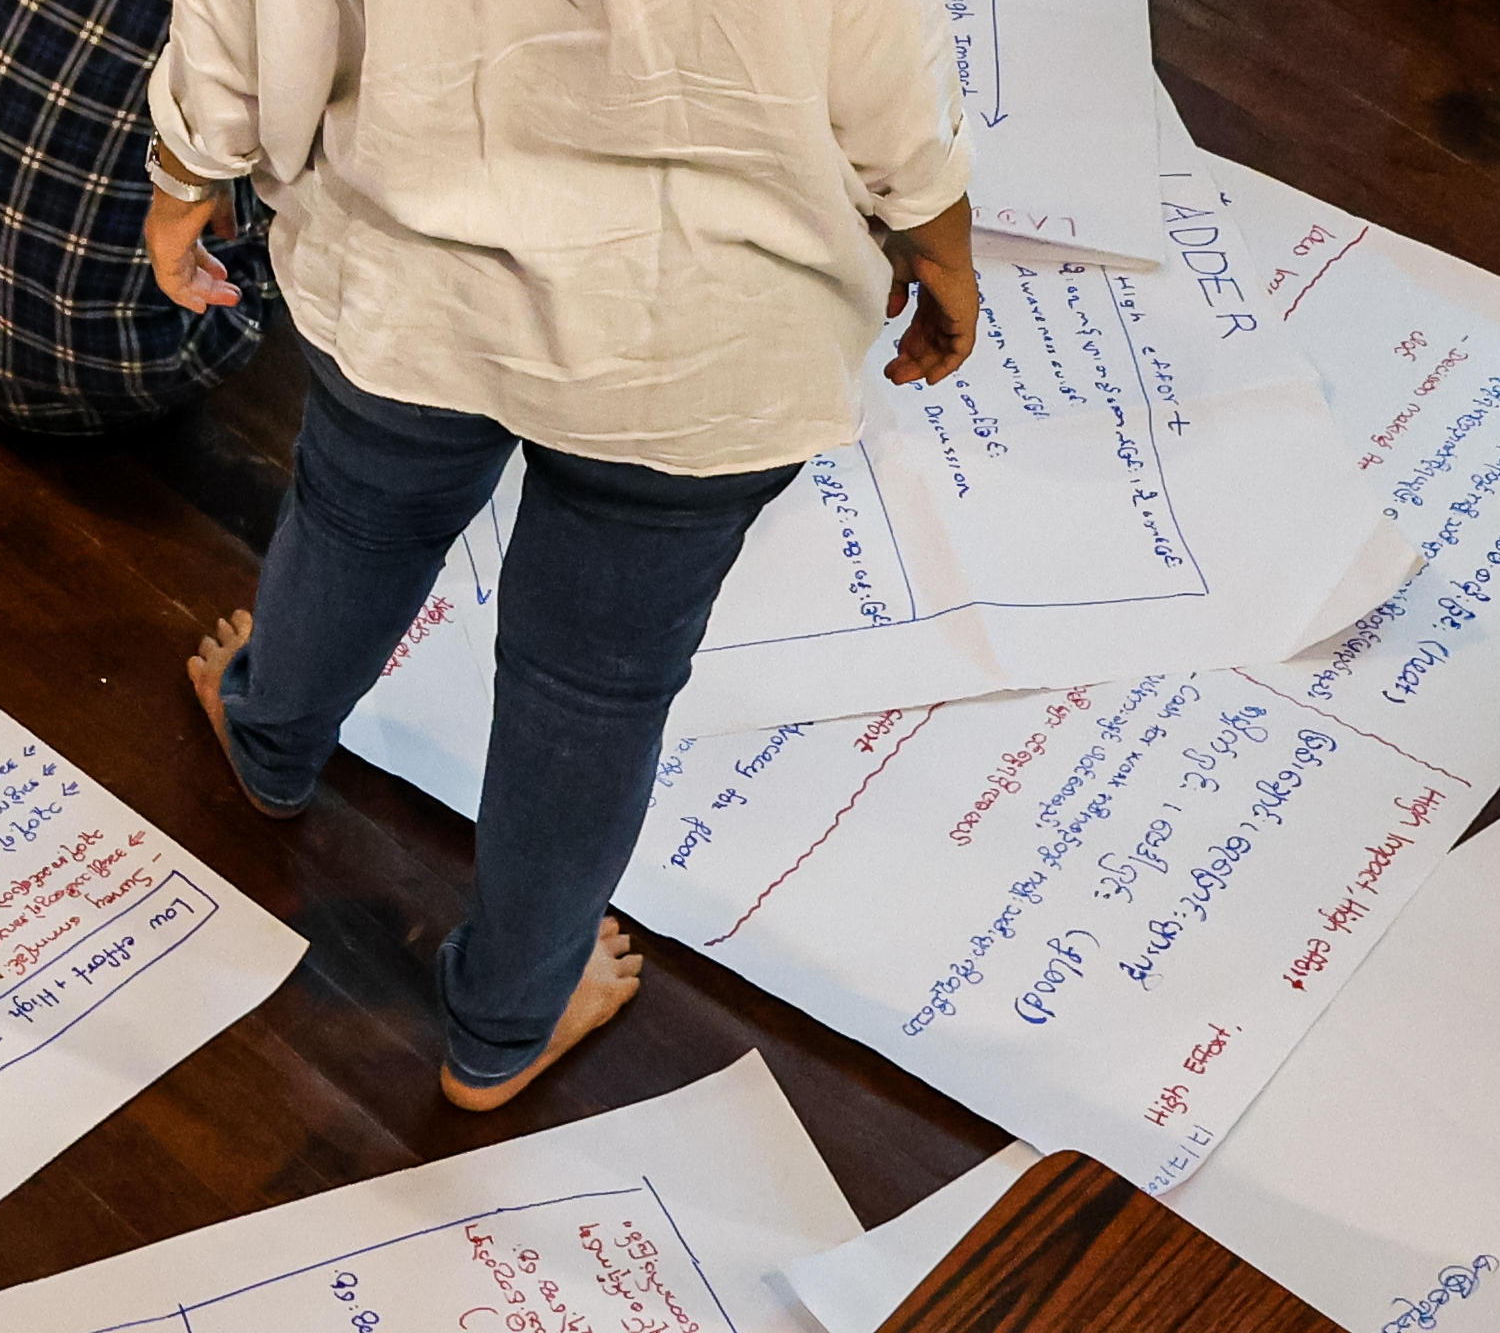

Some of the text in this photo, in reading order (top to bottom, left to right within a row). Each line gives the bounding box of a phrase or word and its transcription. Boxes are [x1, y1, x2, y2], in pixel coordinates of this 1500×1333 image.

[1113, 268, 1146, 324] High
[1412, 347, 1470, 398] Decision
[923, 404, 971, 500] Discussion
[1381, 639, 1450, 705] (heat)
[1392, 785, 1447, 829] High
[148, 896, 196, 931] Low
[1317, 897, 1371, 935] High
[70, 935, 136, 986] effort
[7, 987, 61, 1024] High
[1143, 1086, 1188, 1128] High
